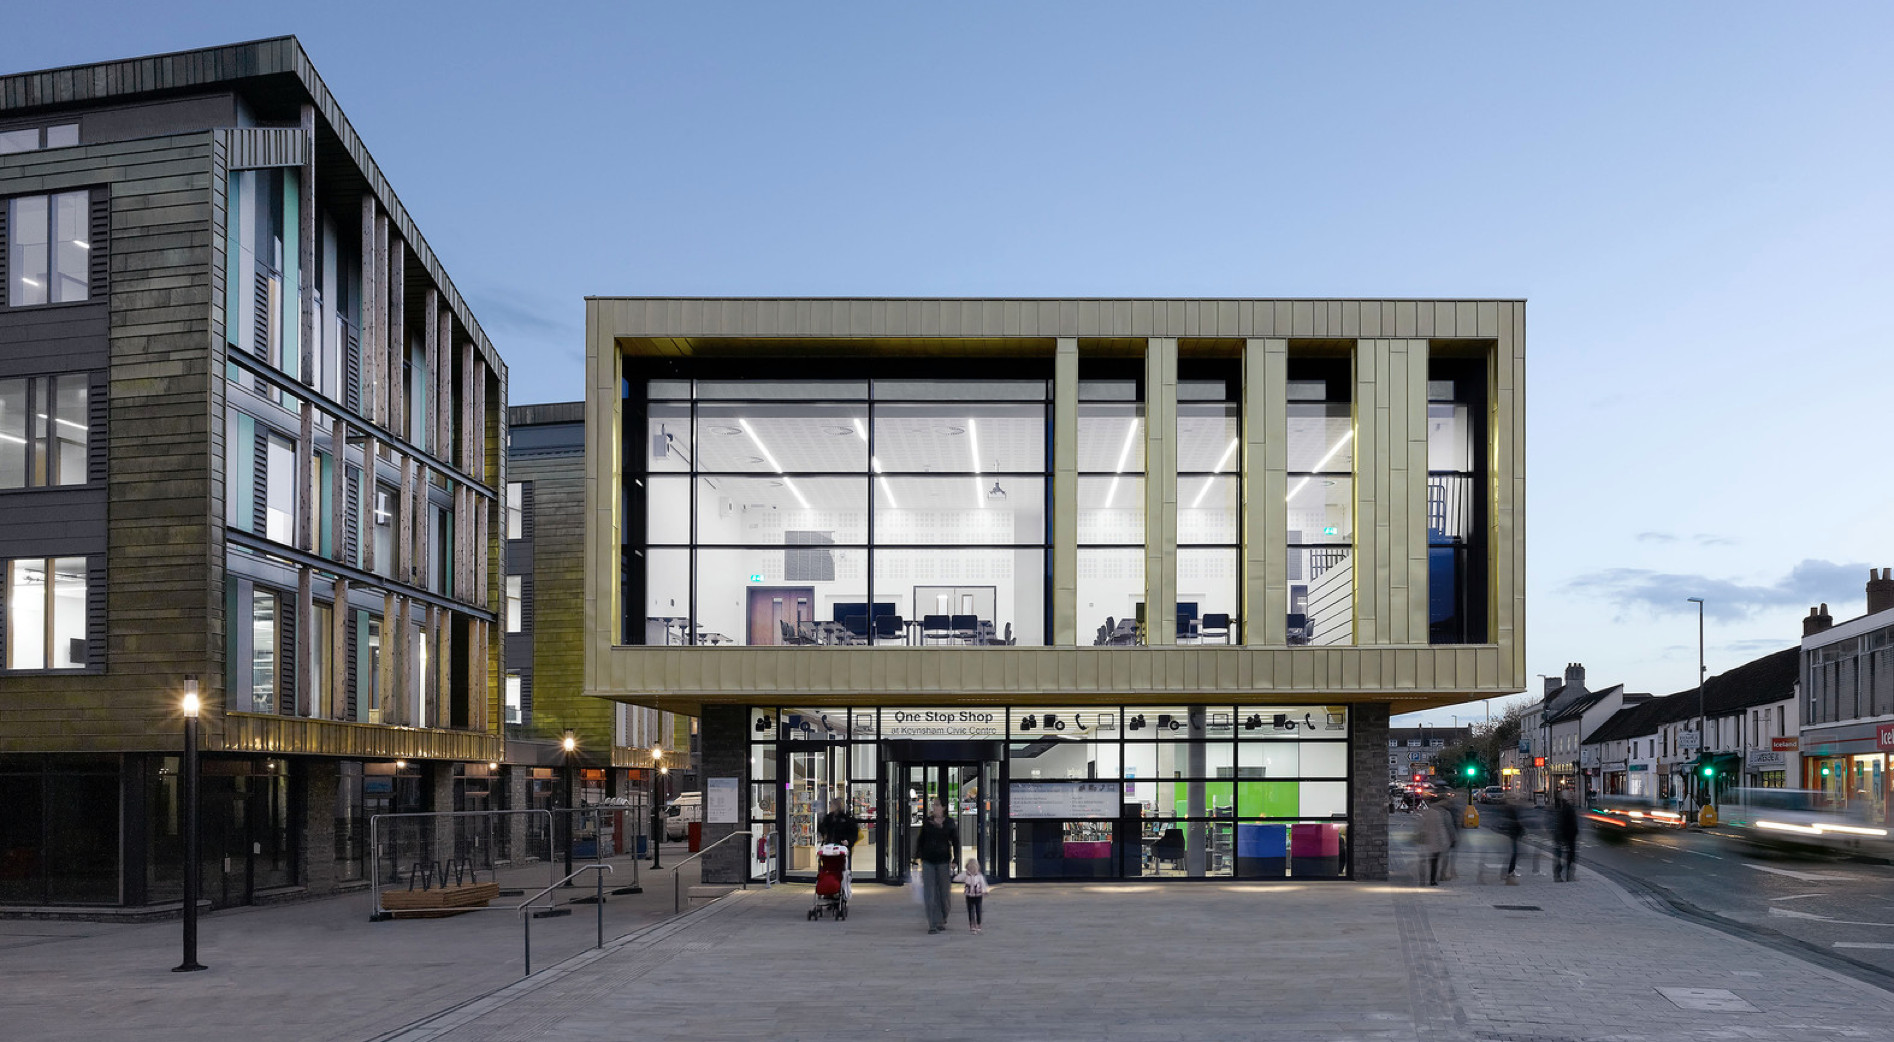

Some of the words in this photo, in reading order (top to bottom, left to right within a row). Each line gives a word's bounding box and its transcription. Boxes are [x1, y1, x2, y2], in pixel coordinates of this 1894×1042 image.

[894, 711, 921, 723] One
[925, 711, 955, 723] Stop
[959, 711, 994, 723] Shop
[901, 726, 944, 735] Keynsham
[946, 726, 967, 734] Civic
